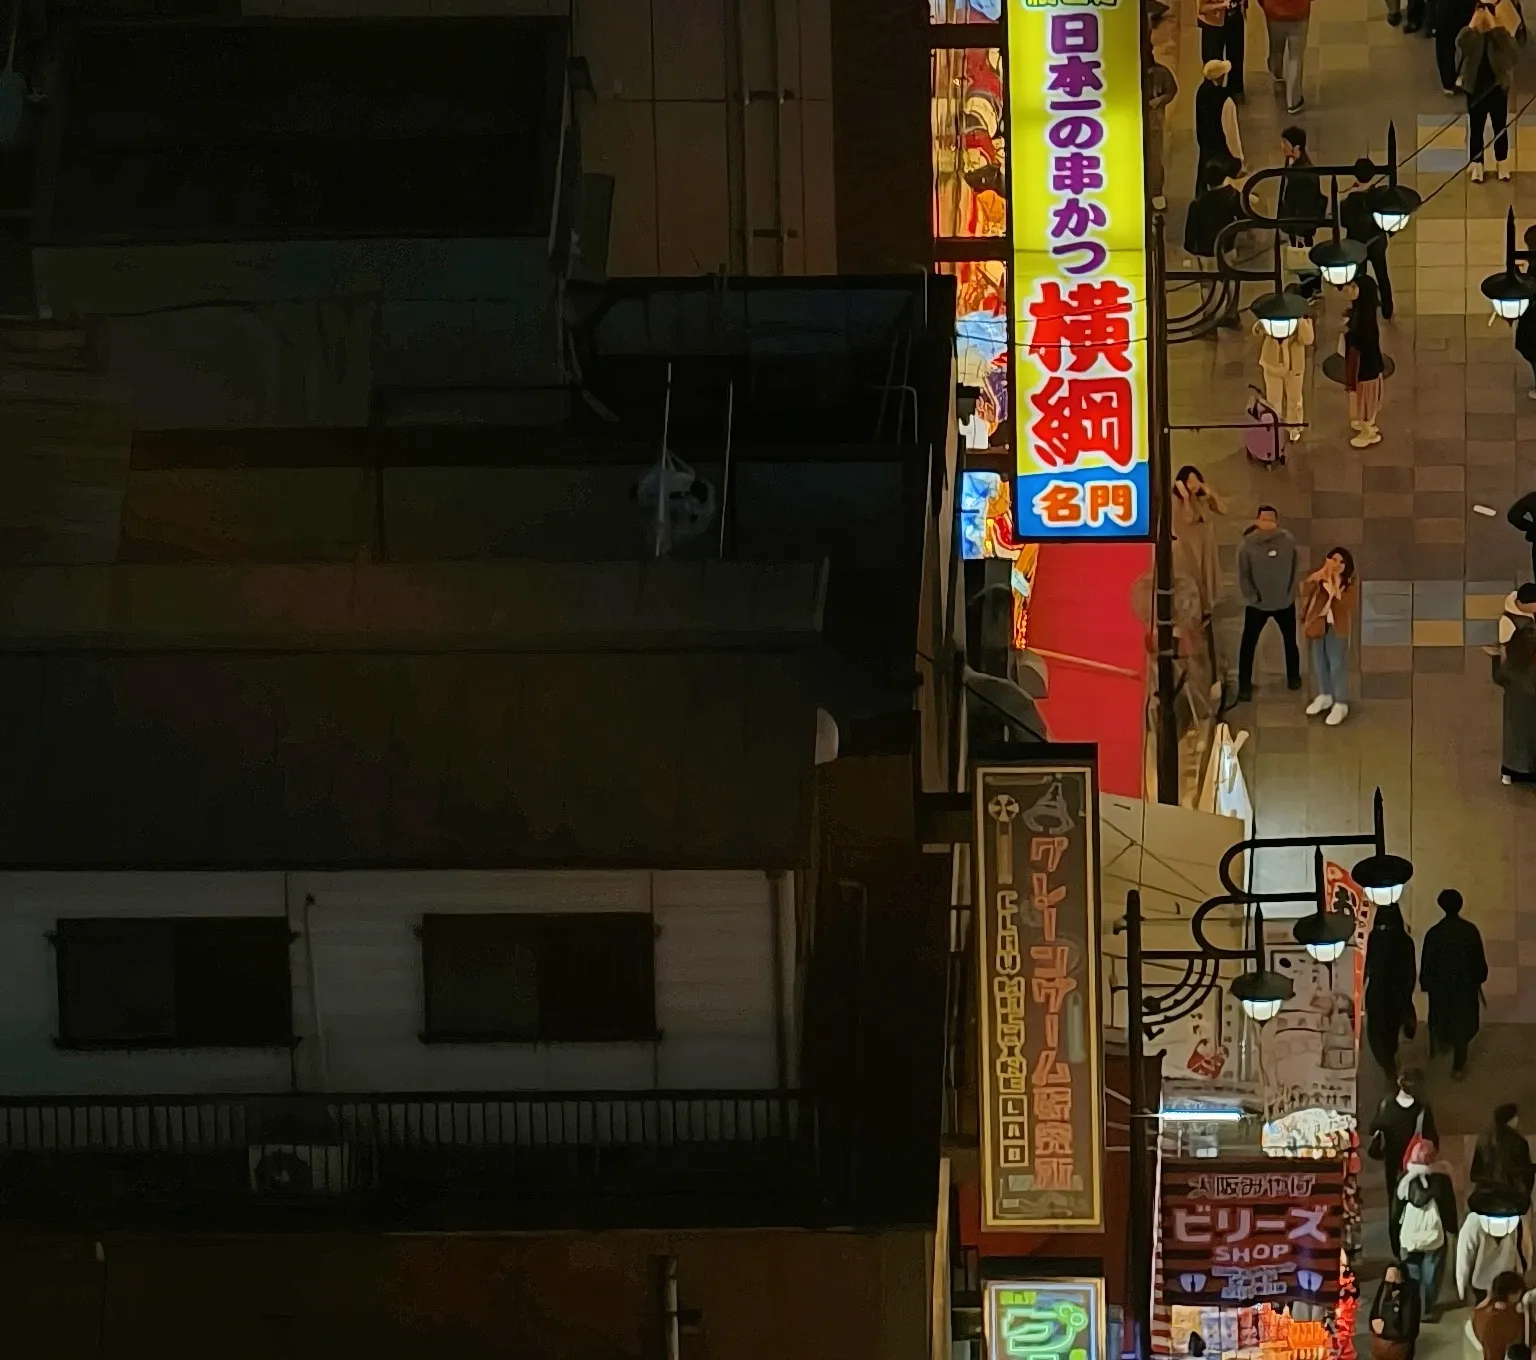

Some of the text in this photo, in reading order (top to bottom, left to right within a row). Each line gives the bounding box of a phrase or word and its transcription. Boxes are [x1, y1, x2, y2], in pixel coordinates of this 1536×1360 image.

[1047, 12, 1109, 276] 日本一の串かつ
[1027, 279, 1135, 469] 横綱
[1040, 482, 1134, 526] 名門
[1173, 1204, 1328, 1243] ビリーズ
[1215, 1243, 1290, 1263] SHOP
